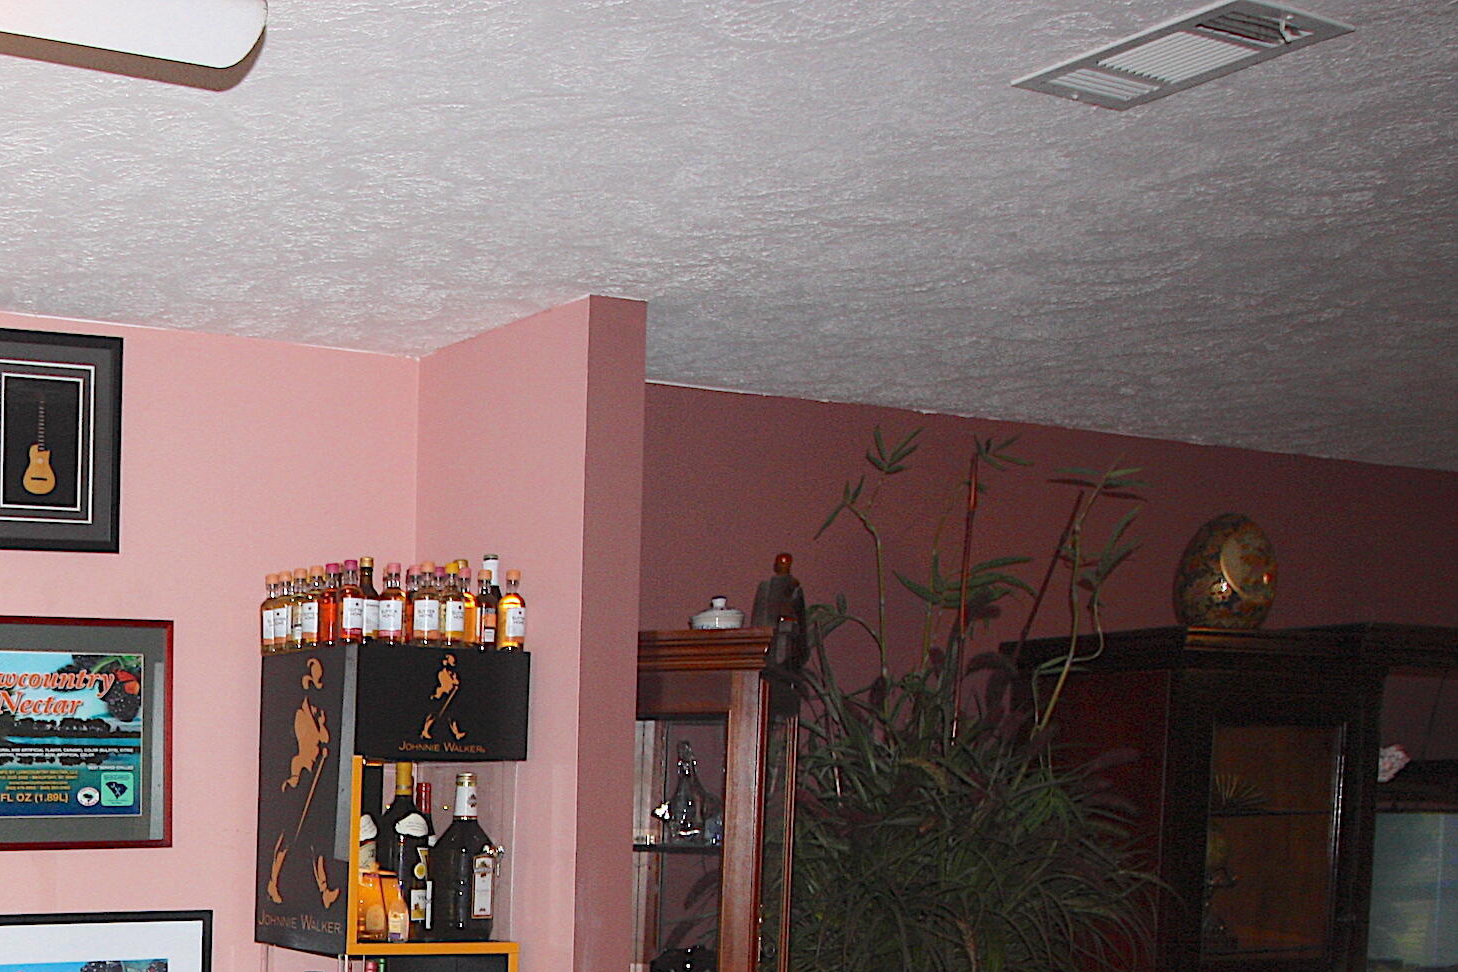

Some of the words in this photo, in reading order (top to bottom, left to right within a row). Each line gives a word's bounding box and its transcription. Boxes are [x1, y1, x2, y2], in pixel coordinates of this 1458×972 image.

[398, 740, 440, 752] JOHNNIE
[443, 742, 484, 753] WALKER
[0, 793, 14, 802] FL
[16, 793, 32, 802] OZ
[34, 792, 69, 803] (1.89L)
[258, 910, 297, 930] JOHNNIE
[300, 914, 342, 934] WALKER
